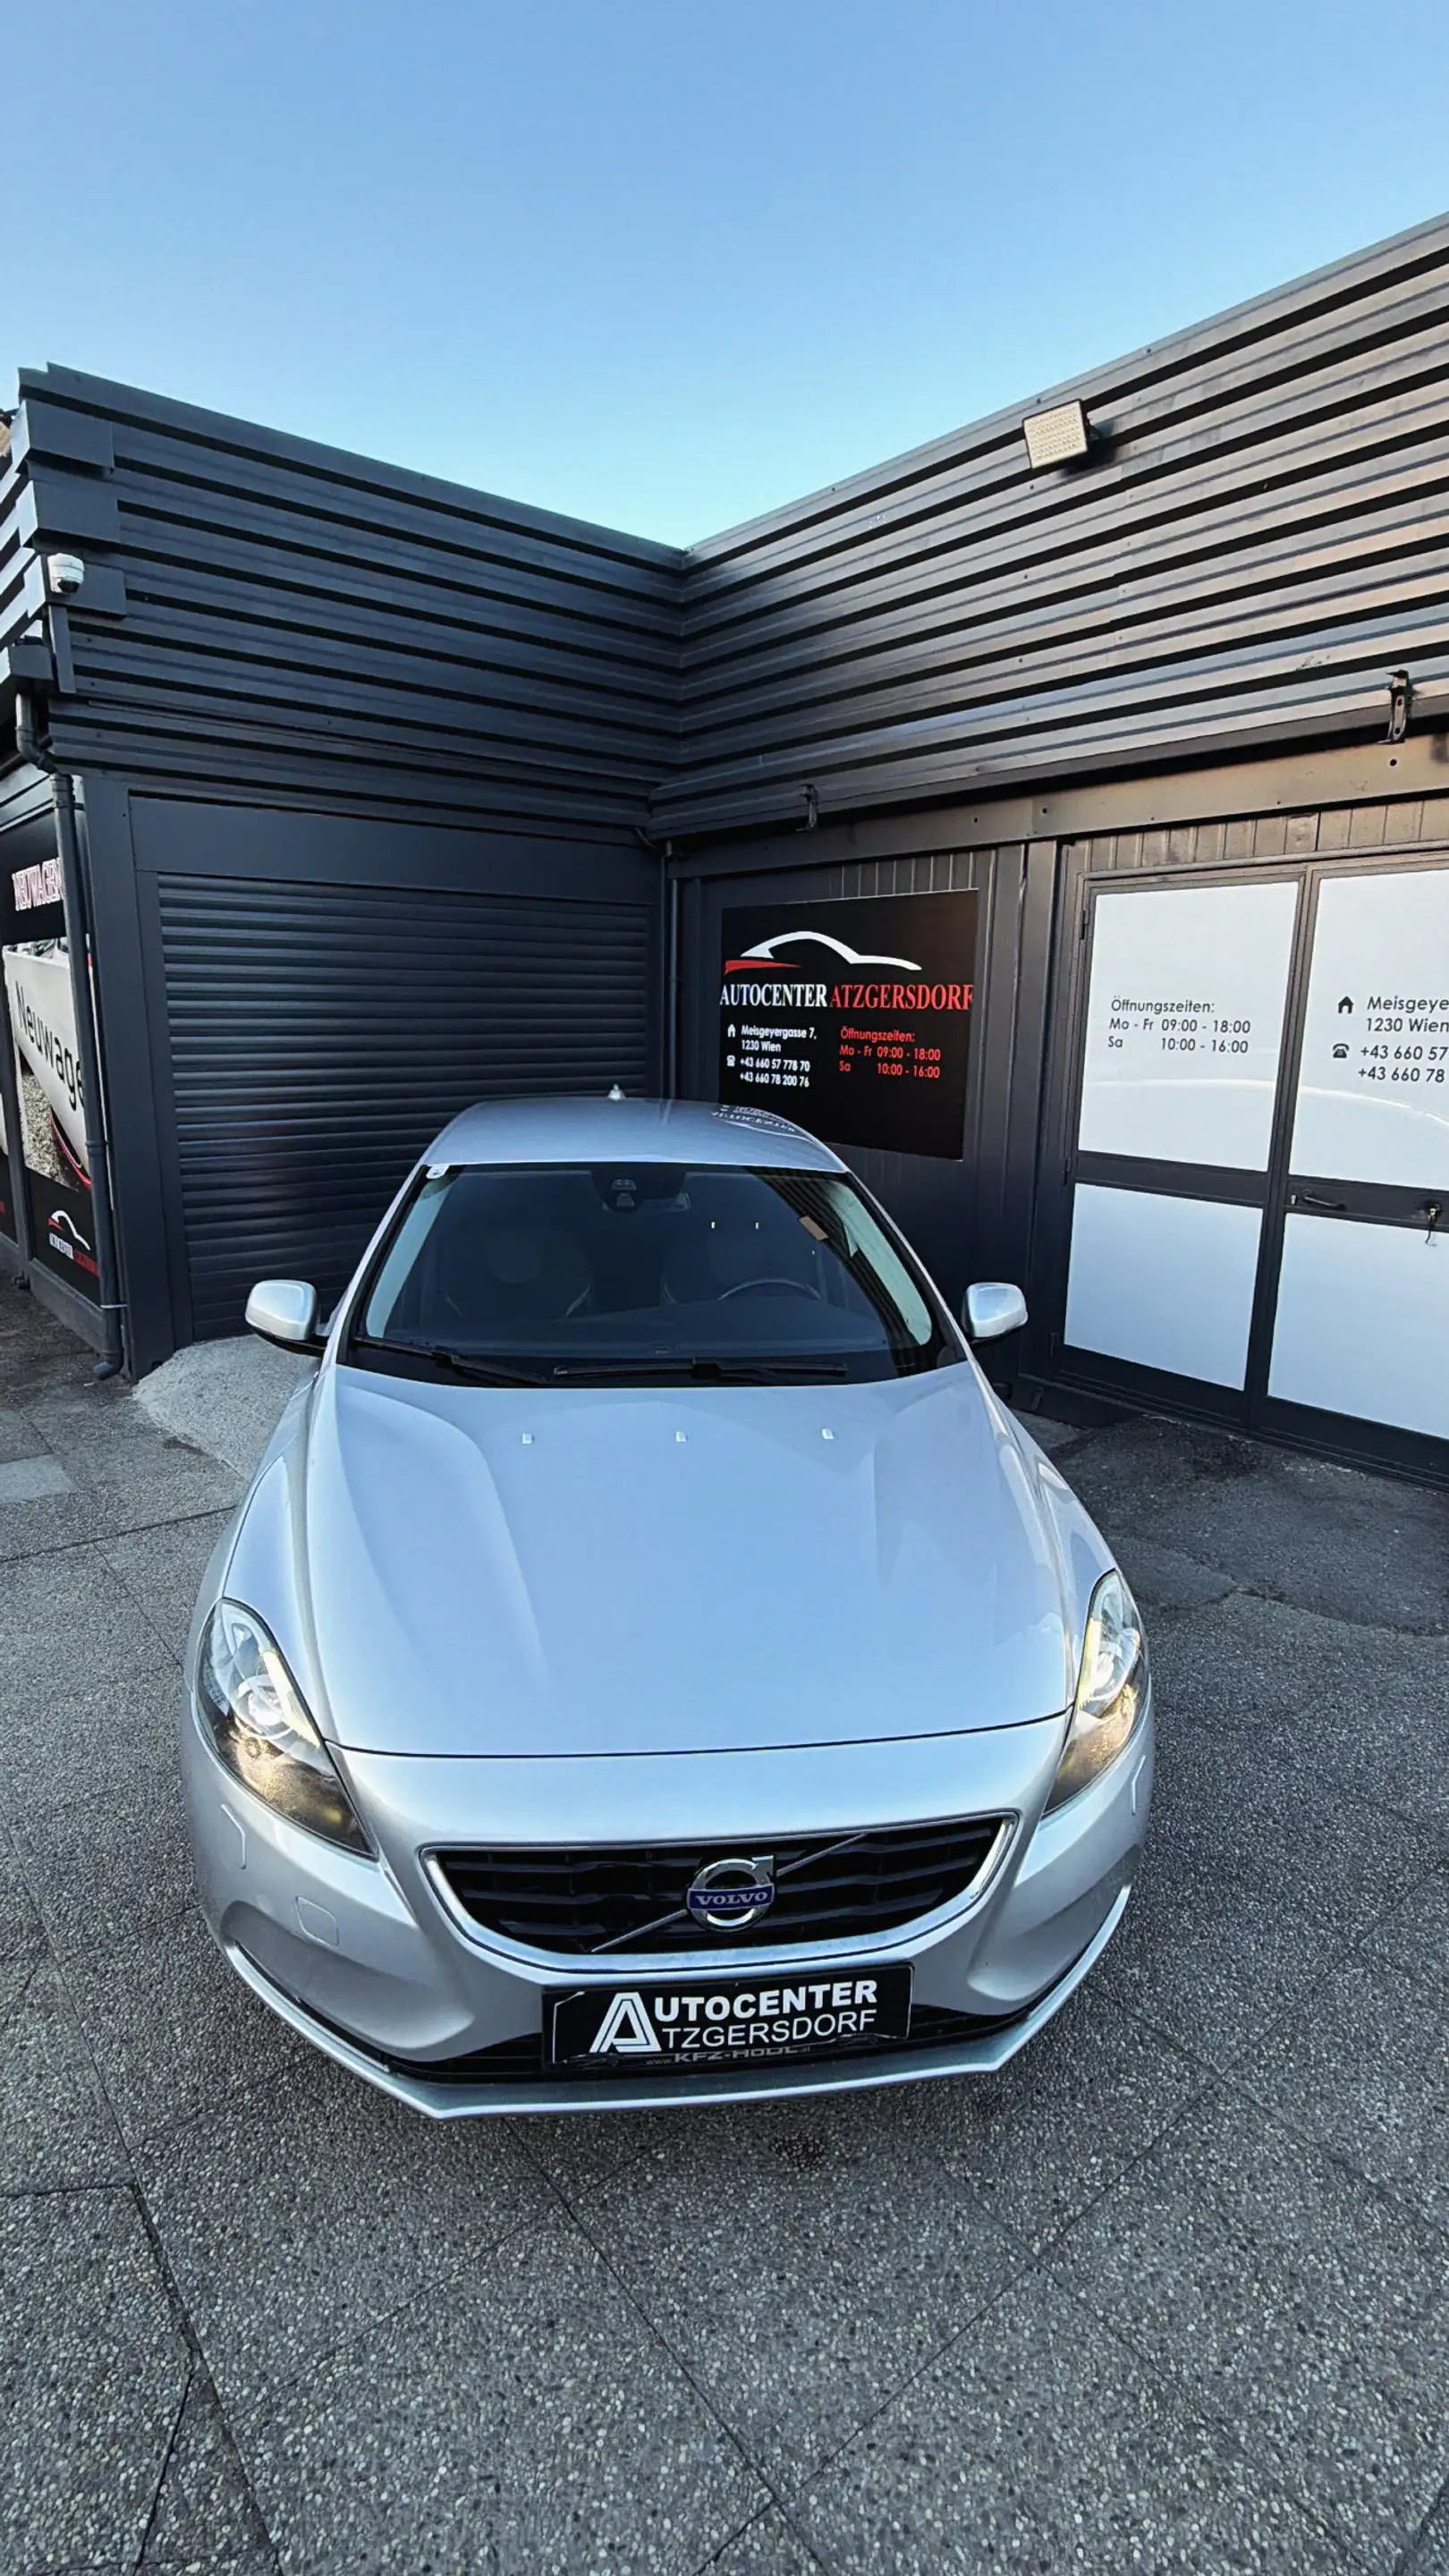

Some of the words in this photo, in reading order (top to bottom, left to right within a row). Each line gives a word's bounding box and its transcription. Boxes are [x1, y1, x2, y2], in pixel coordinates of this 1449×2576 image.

[719, 984, 827, 1007] AUTOCENTER
[830, 984, 973, 1010] ATZGERSDORF
[1111, 996, 1215, 1014] Öffnungszeiten:
[741, 1025, 807, 1039] Meisgeyergasse
[809, 1027, 818, 1039] 7,
[1109, 1018, 1129, 1030] Mo
[1143, 1018, 1154, 1030] Fr
[1161, 1019, 1198, 1031] 09:00
[1213, 1020, 1250, 1033] 18:00
[1367, 1018, 1403, 1032] 1230
[1409, 1018, 1449, 1032] Wien
[841, 1025, 915, 1043] Öffnungszeiten:
[741, 1039, 759, 1050] 1230
[760, 1040, 781, 1052] Wien
[839, 1044, 854, 1055] Mo
[863, 1045, 872, 1056] Fr
[877, 1046, 903, 1058] 09:00
[913, 1047, 941, 1061] 18:00
[1108, 1036, 1123, 1048] Sa
[1161, 1038, 1196, 1051] 10:00
[1211, 1039, 1249, 1053] 16:00
[1360, 1045, 1388, 1059] +43
[1394, 1046, 1423, 1060] 660
[1428, 1046, 1448, 1061] 57
[740, 1056, 753, 1067] +43
[755, 1058, 770, 1069] 660
[771, 1059, 781, 1070] 57
[783, 1060, 798, 1071] 778
[800, 1060, 810, 1072] 70
[839, 1060, 851, 1072] Sa
[877, 1063, 902, 1075] 10:00
[913, 1065, 940, 1079] 16:00
[740, 1072, 753, 1082] +43
[755, 1073, 769, 1083] 660
[771, 1073, 781, 1085] 78
[783, 1075, 797, 1086] 200
[799, 1076, 809, 1088] 76
[1358, 1066, 1385, 1080] +43
[1391, 1067, 1419, 1081] 660
[1426, 1068, 1445, 1083] 78
[695, 1890, 768, 1906] VOLVO
